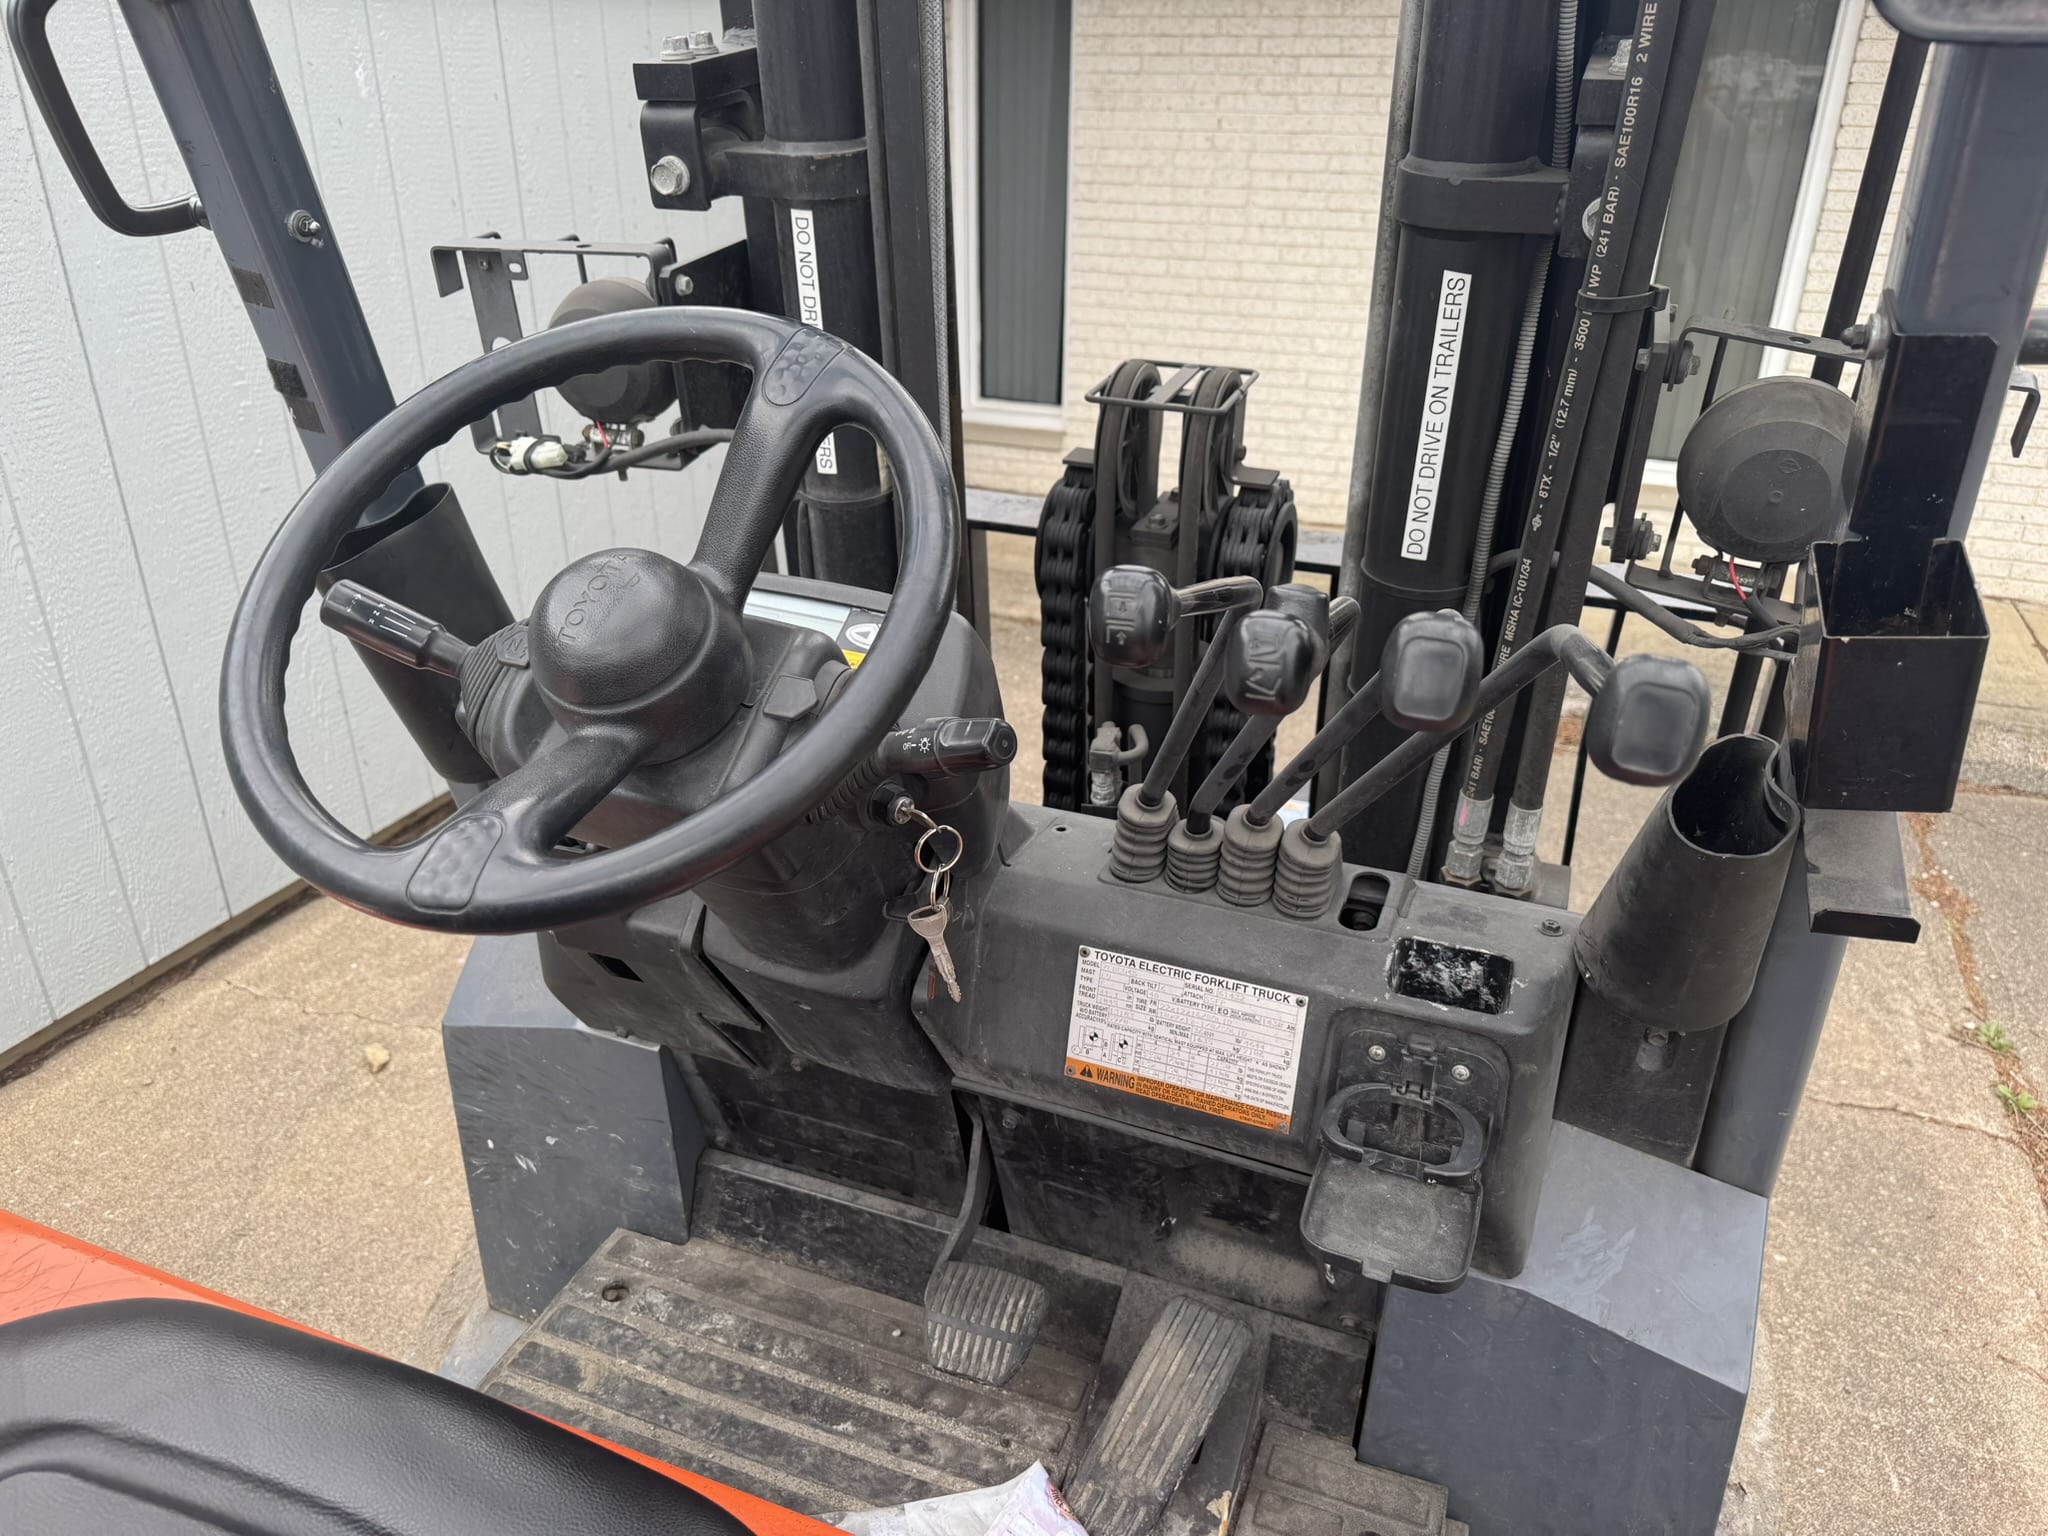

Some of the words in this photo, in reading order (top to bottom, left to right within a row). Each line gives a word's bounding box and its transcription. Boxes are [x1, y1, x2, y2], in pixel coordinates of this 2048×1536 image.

[1637, 2, 1657, 48] WIRE
[1635, 52, 1648, 62] 2
[1614, 76, 1643, 168] SAE100R16
[1602, 186, 1620, 224] BAR)
[796, 216, 810, 245] DO
[1595, 229, 1611, 257] (241
[798, 252, 815, 290] NOT
[1587, 264, 1601, 287] WP
[1433, 277, 1465, 379] TRAILERS
[1573, 318, 1590, 350] 3500
[1563, 368, 1577, 396] mm)
[1428, 385, 1449, 415] ON
[1554, 398, 1570, 428] (12.7
[1418, 420, 1443, 479] DRIVE
[1411, 483, 1432, 523] NOT
[1406, 528, 1425, 555] DO
[1503, 609, 1520, 641] MSHA
[1080, 966, 1095, 975] MAST
[1081, 958, 1100, 968] MODEL
[1078, 984, 1096, 993] FRONT
[1079, 975, 1093, 983] TYPE
[1094, 950, 1136, 968] TOYOTA
[1138, 960, 1192, 980] ELECTRIC
[1194, 973, 1249, 993] FORKLIFT
[1251, 986, 1290, 1004] TRUCK
[1123, 985, 1146, 995] VOLTAGE
[1130, 978, 1145, 987] BACK
[1184, 982, 1203, 991] SERIAL
[1077, 990, 1095, 999] TREAD
[1077, 1000, 1091, 1008] TRUCK
[1091, 1003, 1108, 1012] WEIGHT
[1175, 997, 1199, 1008] BATTERY
[1200, 1003, 1214, 1011] TYPE
[1183, 990, 1204, 1000] ATTACH
[1088, 1009, 1107, 1018] BATTERY
[1156, 1019, 1174, 1028] BATTERY
[1096, 1067, 1135, 1089] WARNING
[1135, 1087, 1150, 1096] READ
[1185, 1100, 1208, 1111] MANUAL
[1142, 1083, 1160, 1092] INJURY
[1192, 1096, 1216, 1106] TRAINED
[1216, 1102, 1250, 1115] OPERATORS
[1165, 1083, 1195, 1096] OPERATION
[1205, 1093, 1244, 1108] MAINTENANCE
[1245, 1104, 1265, 1114] COULD
[1266, 1109, 1287, 1119] RESULT
